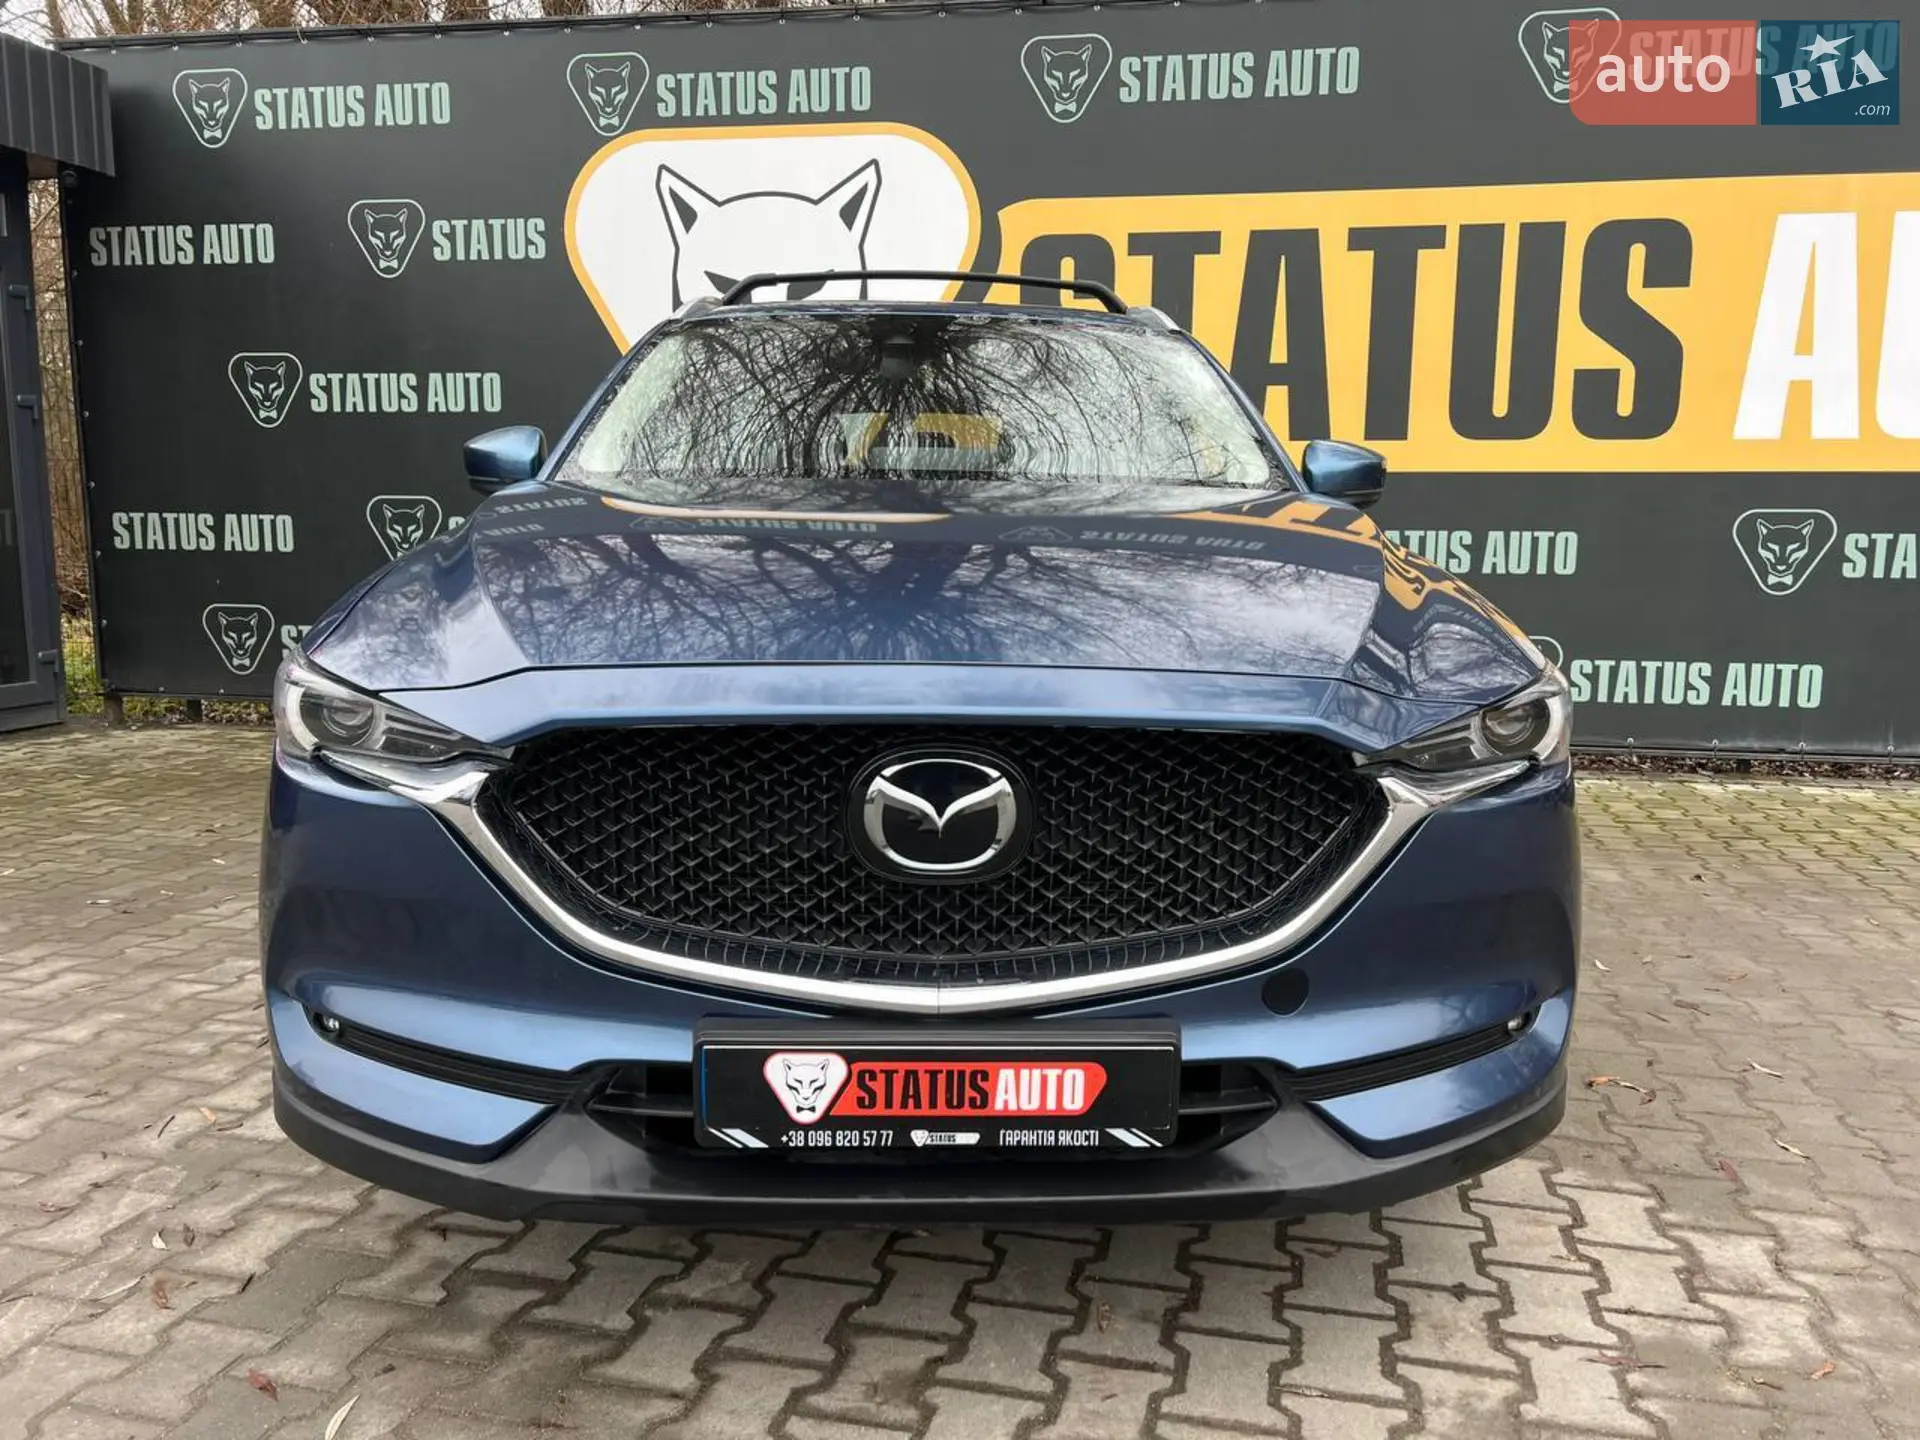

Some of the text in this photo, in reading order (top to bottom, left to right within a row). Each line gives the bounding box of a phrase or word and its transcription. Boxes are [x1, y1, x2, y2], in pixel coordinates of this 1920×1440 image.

[656, 66, 871, 118] STATUS AUTO
[1119, 46, 1360, 103] STATUS AUTO
[254, 82, 451, 130] STATUS AUTO
[90, 223, 275, 266] STATUS AUTO
[432, 218, 546, 261] STATUS
[310, 372, 502, 413] STATUS AUTO
[113, 512, 294, 553] STATUS AUTO
[1481, 530, 1579, 575] AUTO
[1570, 659, 1824, 709] STATUS AUTO
[856, 1068, 1085, 1111] STATUS AUTO
[781, 1130, 894, 1147] +38 096 820 57 77
[999, 1129, 1099, 1146] ГАРАНТІЯ ЯКОСТІ
